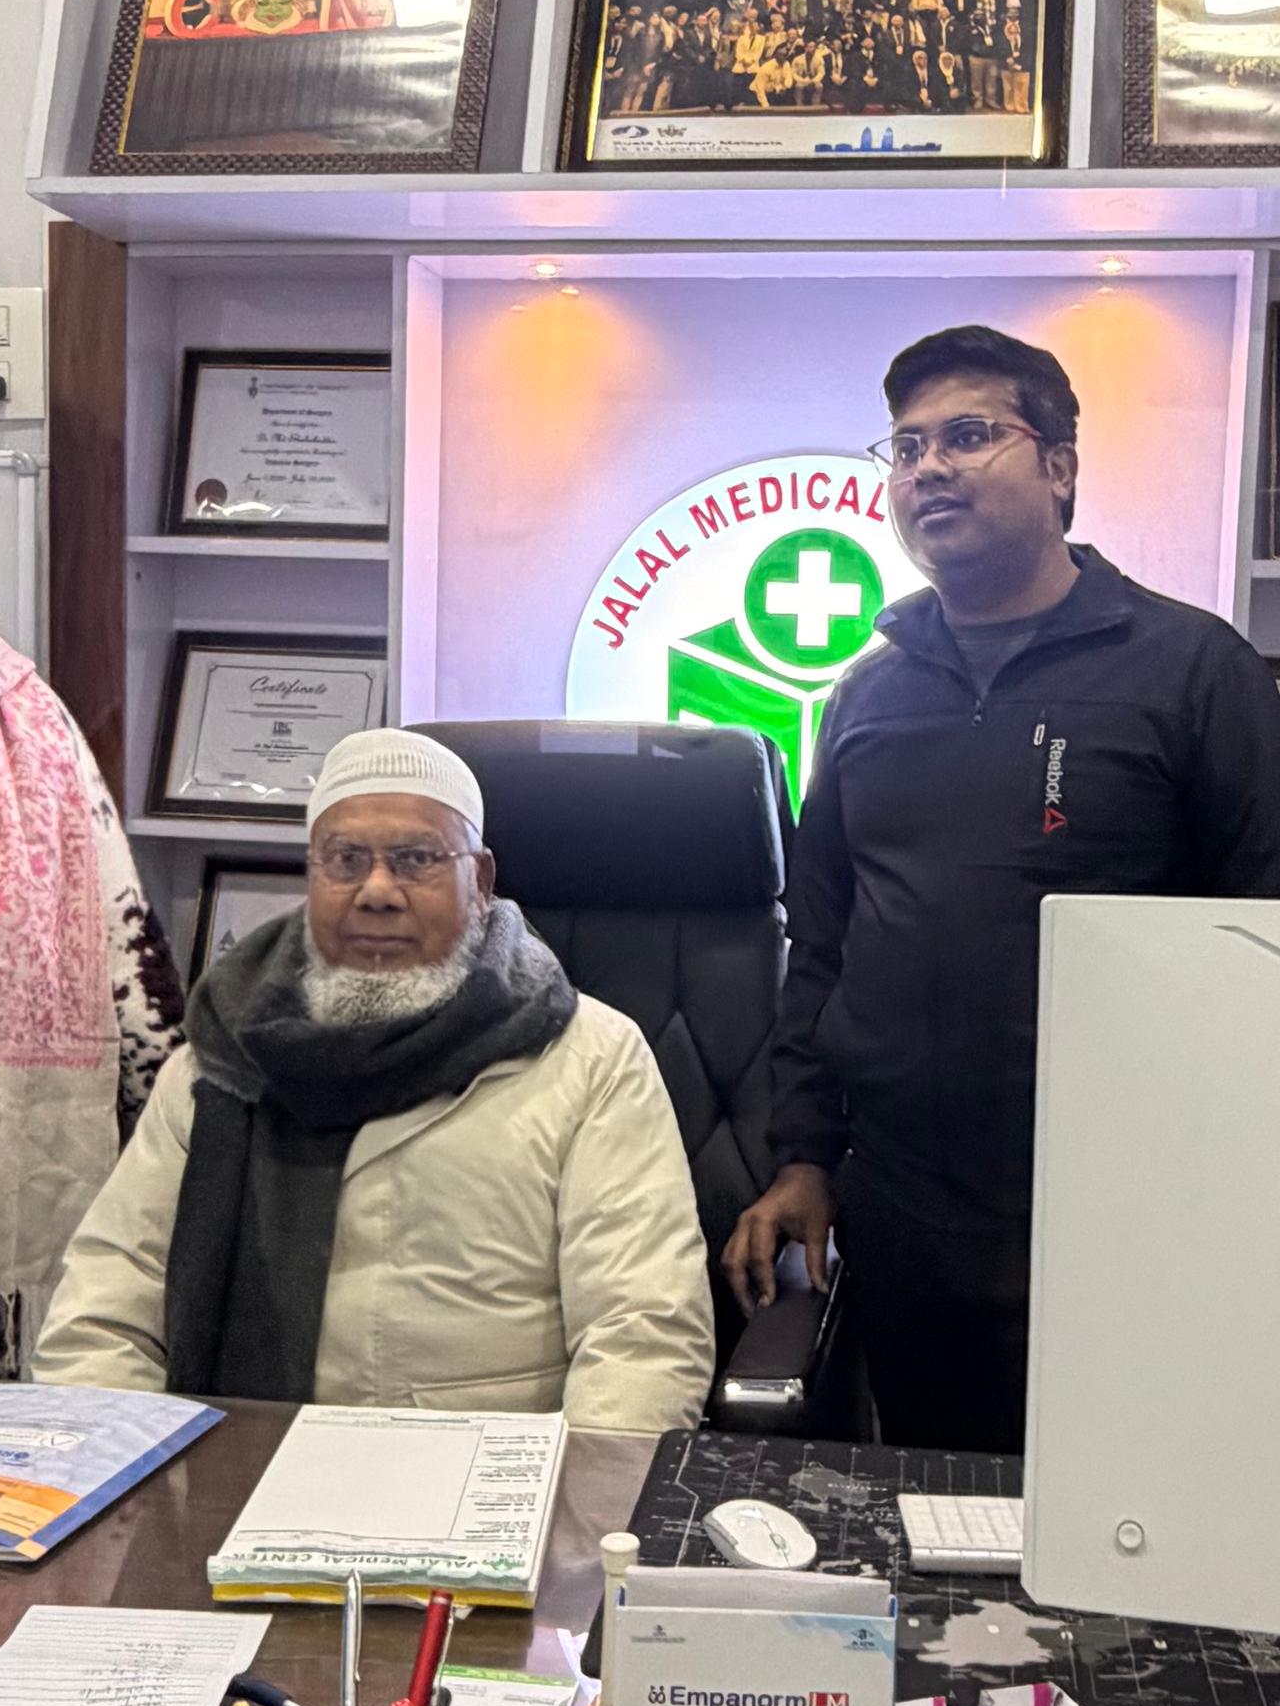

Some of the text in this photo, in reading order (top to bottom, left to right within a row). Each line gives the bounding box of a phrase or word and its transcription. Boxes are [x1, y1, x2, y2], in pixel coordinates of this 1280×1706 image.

[593, 472, 888, 651] JALAL MEDICAL
[1045, 738, 1067, 805] Reebok
[232, 1552, 479, 1569] JALAL MEDICAL CENTER
